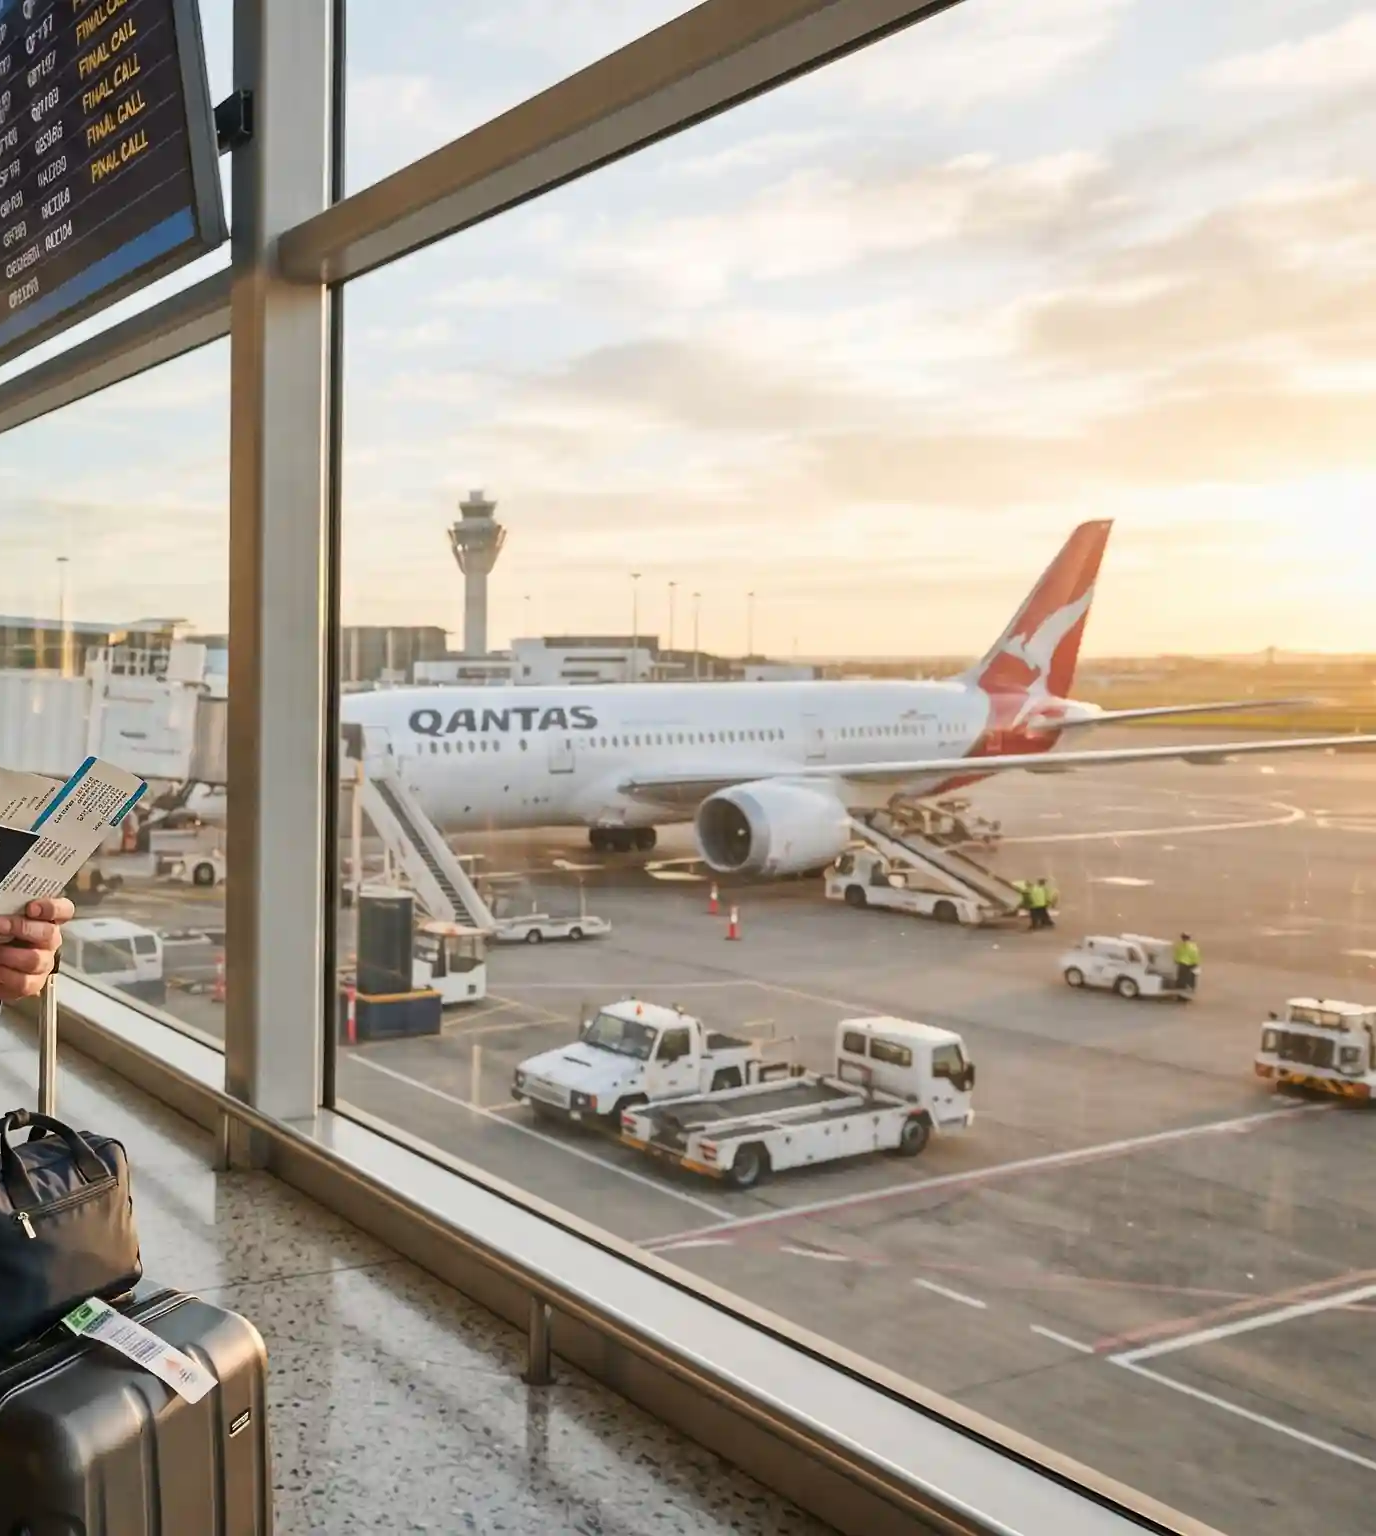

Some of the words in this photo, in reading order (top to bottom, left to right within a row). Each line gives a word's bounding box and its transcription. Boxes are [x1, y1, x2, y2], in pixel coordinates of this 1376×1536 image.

[76, 5, 108, 47] FINAL
[79, 42, 111, 80] FINAL
[83, 77, 114, 115] FINAL
[114, 52, 141, 87] CALL
[87, 112, 117, 149] FINAL
[121, 128, 149, 162] CALL
[408, 705, 599, 738] QANTAS
